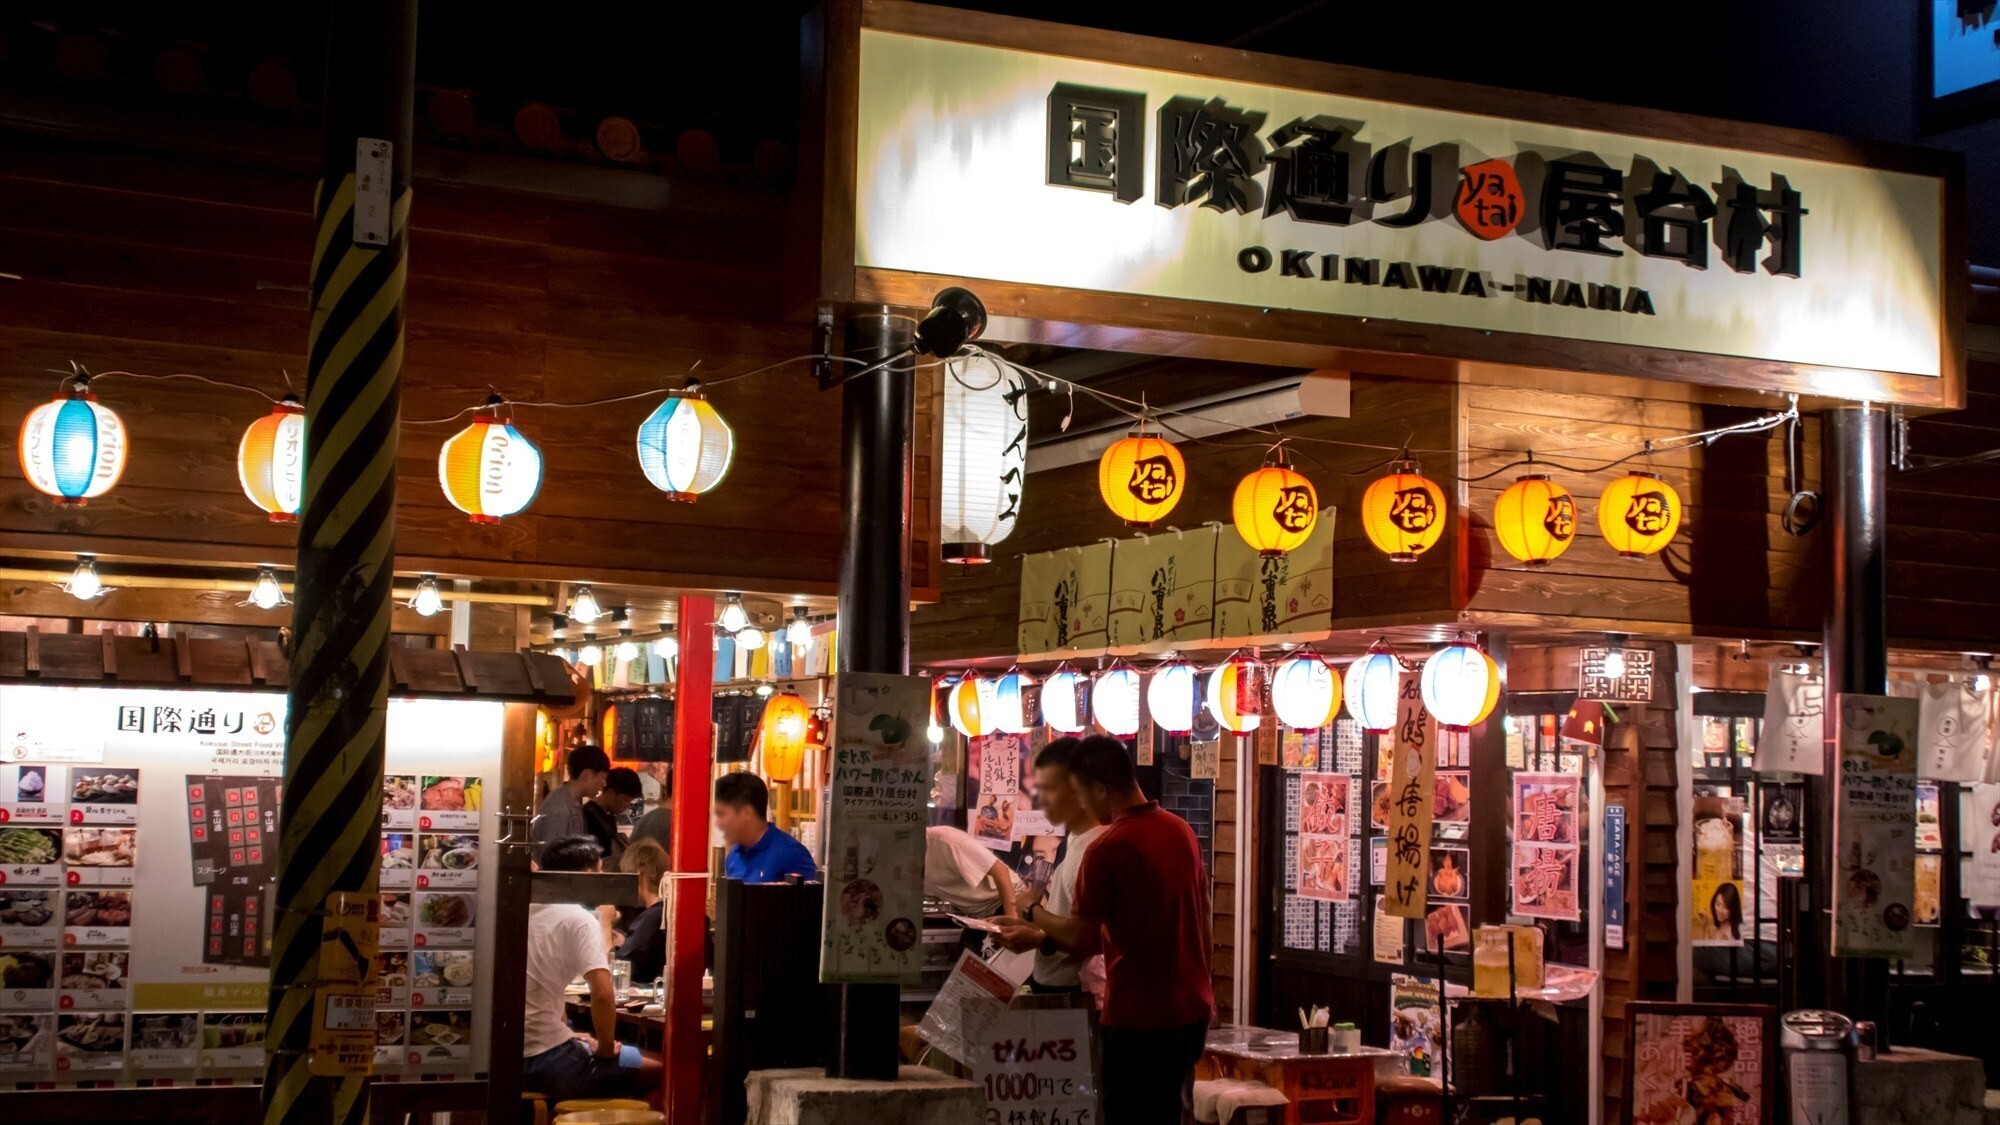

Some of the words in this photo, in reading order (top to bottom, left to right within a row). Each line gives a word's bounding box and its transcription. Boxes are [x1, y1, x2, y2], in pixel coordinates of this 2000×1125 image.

[1046, 83, 1433, 228] 国際通り
[1541, 158, 1809, 279] 屋台村
[117, 705, 244, 735] 国際通り
[842, 785, 917, 800] 国際通り屋台村
[1526, 792, 1566, 898] 唐揚
[984, 1071, 1074, 1101] 1000円で
